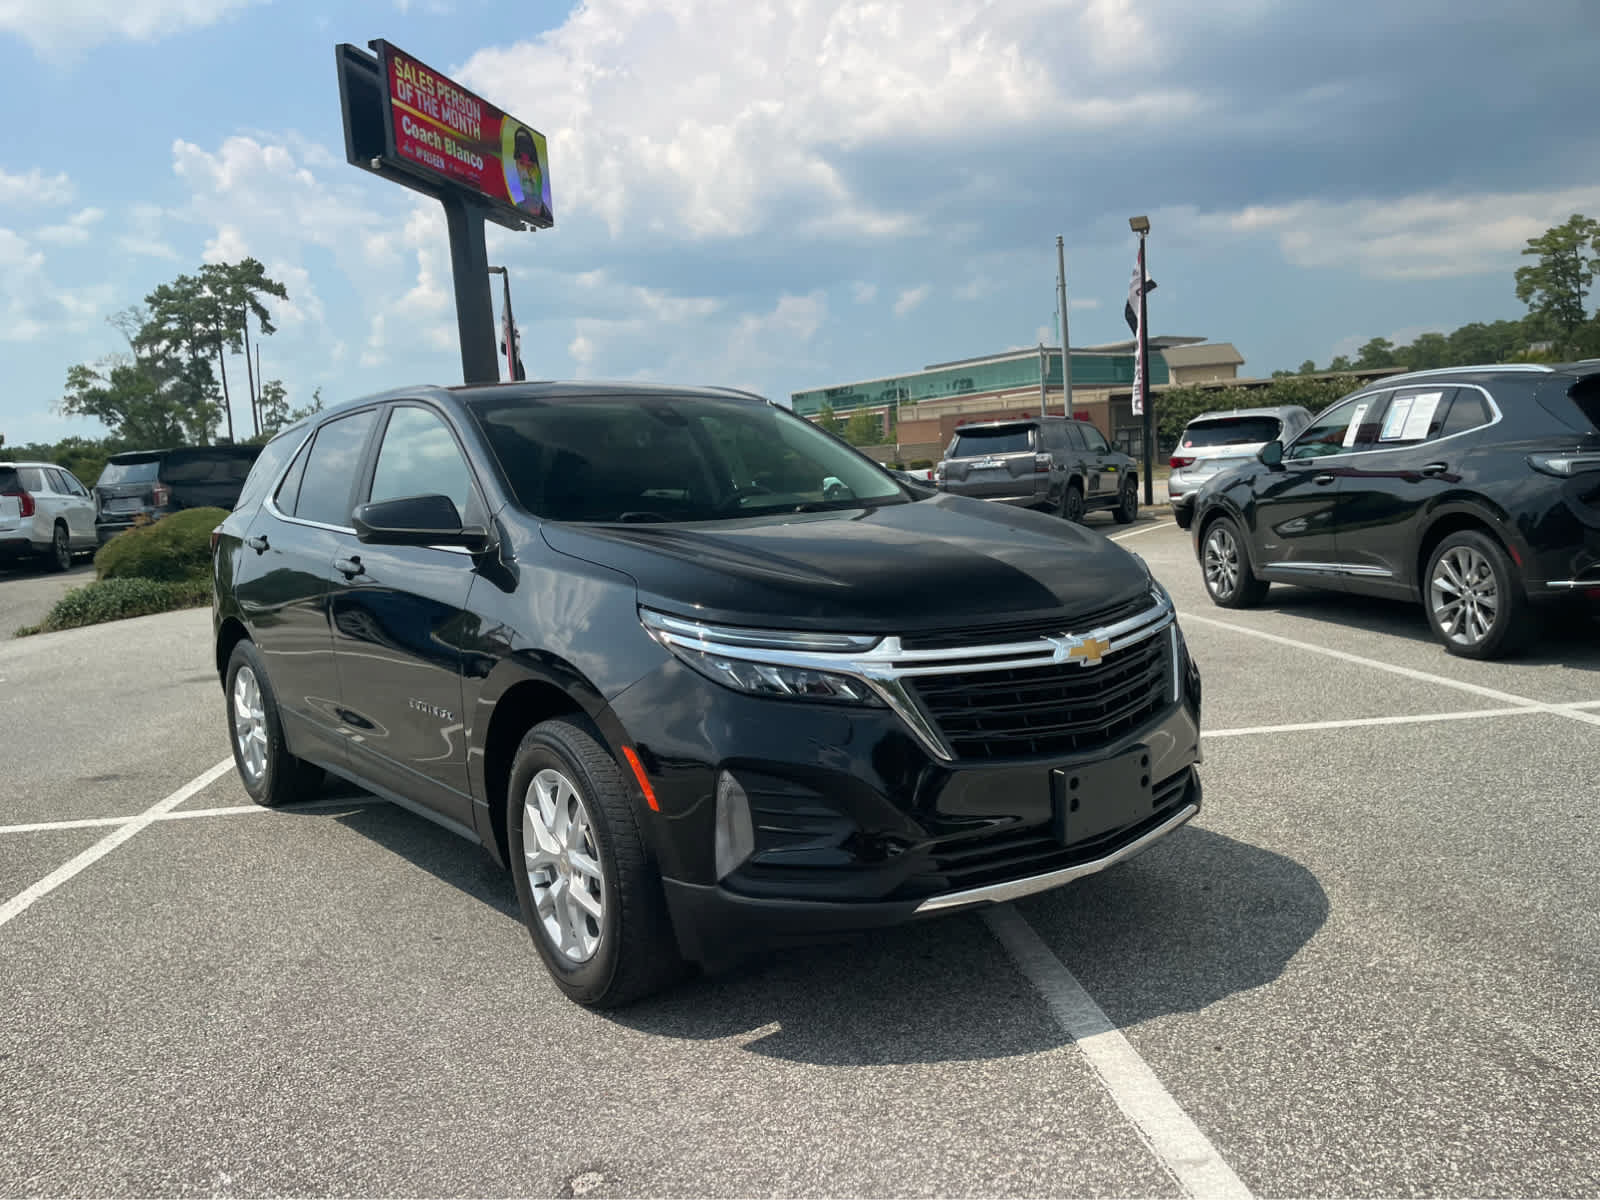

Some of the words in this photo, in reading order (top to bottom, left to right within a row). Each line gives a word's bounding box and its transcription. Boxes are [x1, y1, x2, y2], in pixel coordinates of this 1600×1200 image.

[394, 56, 435, 97] SALES
[436, 81, 481, 122] PERSON
[396, 78, 413, 104] OF
[415, 89, 440, 119] THE
[441, 103, 481, 141] MONTH
[401, 115, 442, 151] Coach
[444, 137, 484, 171] Blanco
